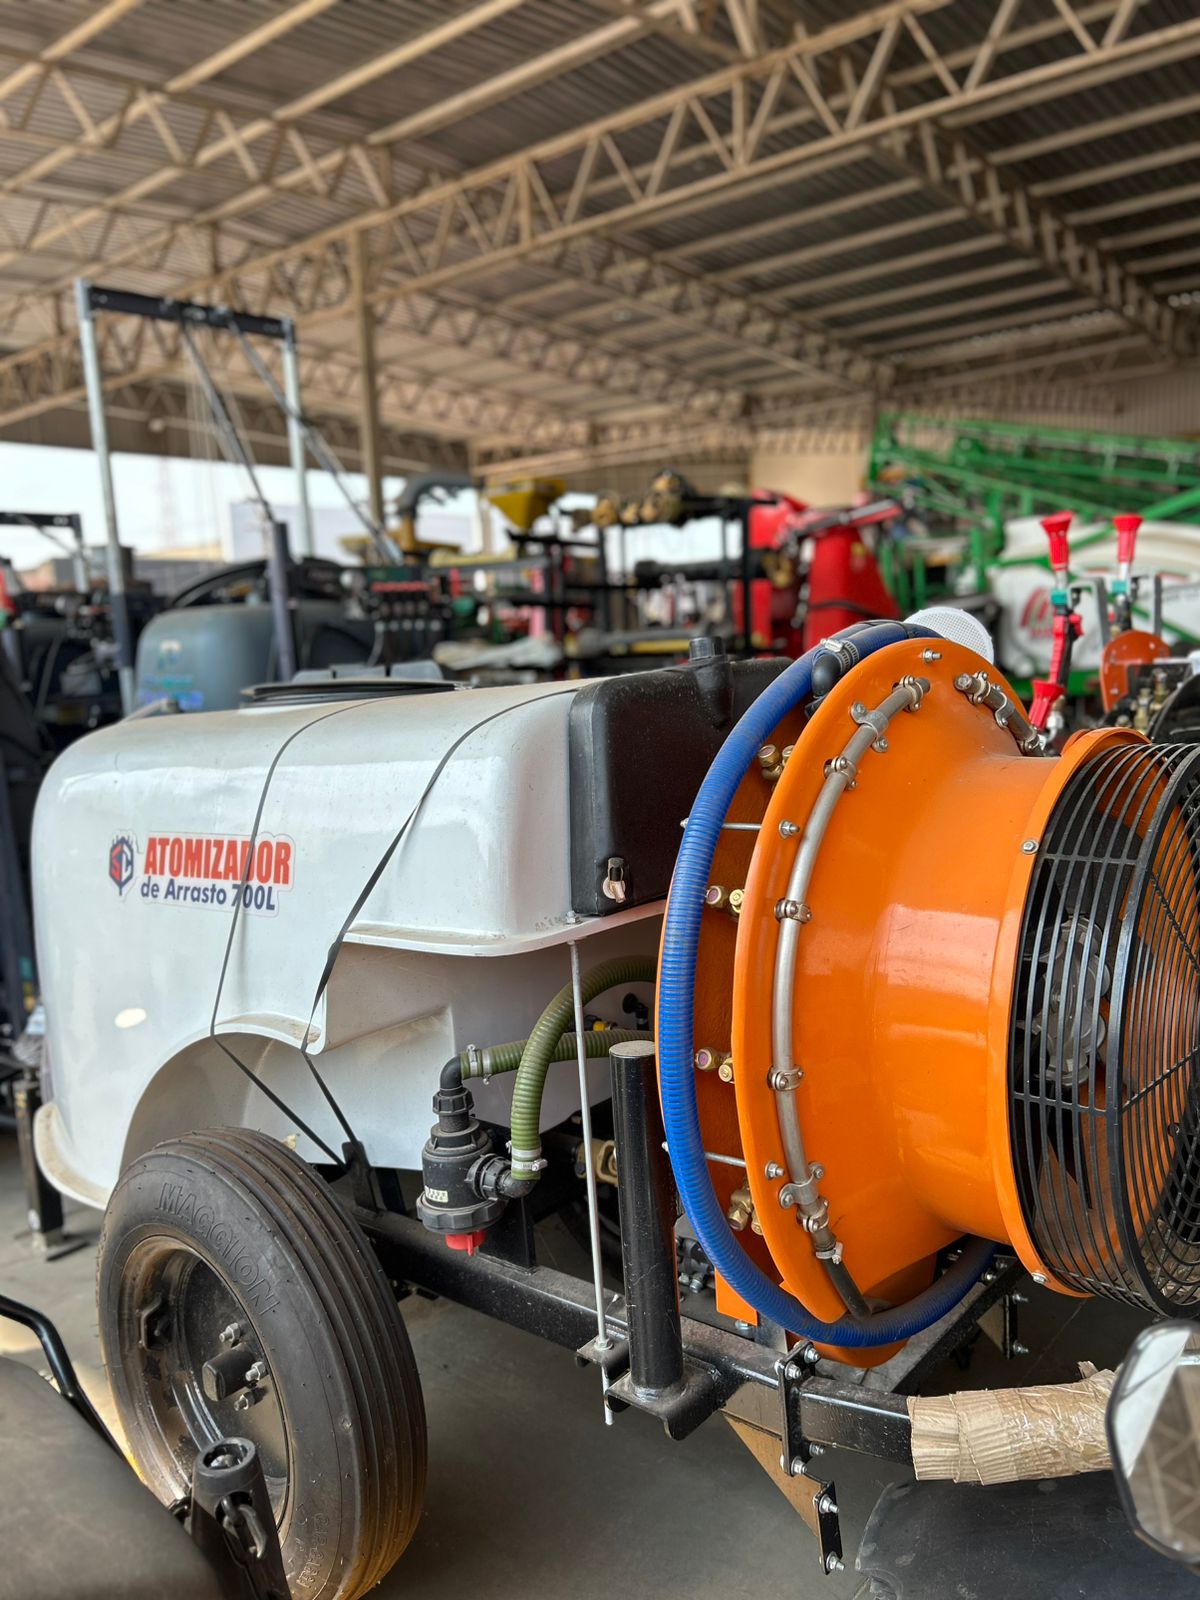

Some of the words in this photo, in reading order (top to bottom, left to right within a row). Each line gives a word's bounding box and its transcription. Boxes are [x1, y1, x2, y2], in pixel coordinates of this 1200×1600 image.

[144, 837, 291, 884] ATOMIZADOR
[141, 876, 160, 898] de
[164, 878, 227, 905] Arrasto
[231, 883, 275, 911] 700L
[155, 1182, 280, 1316] MAGGION
